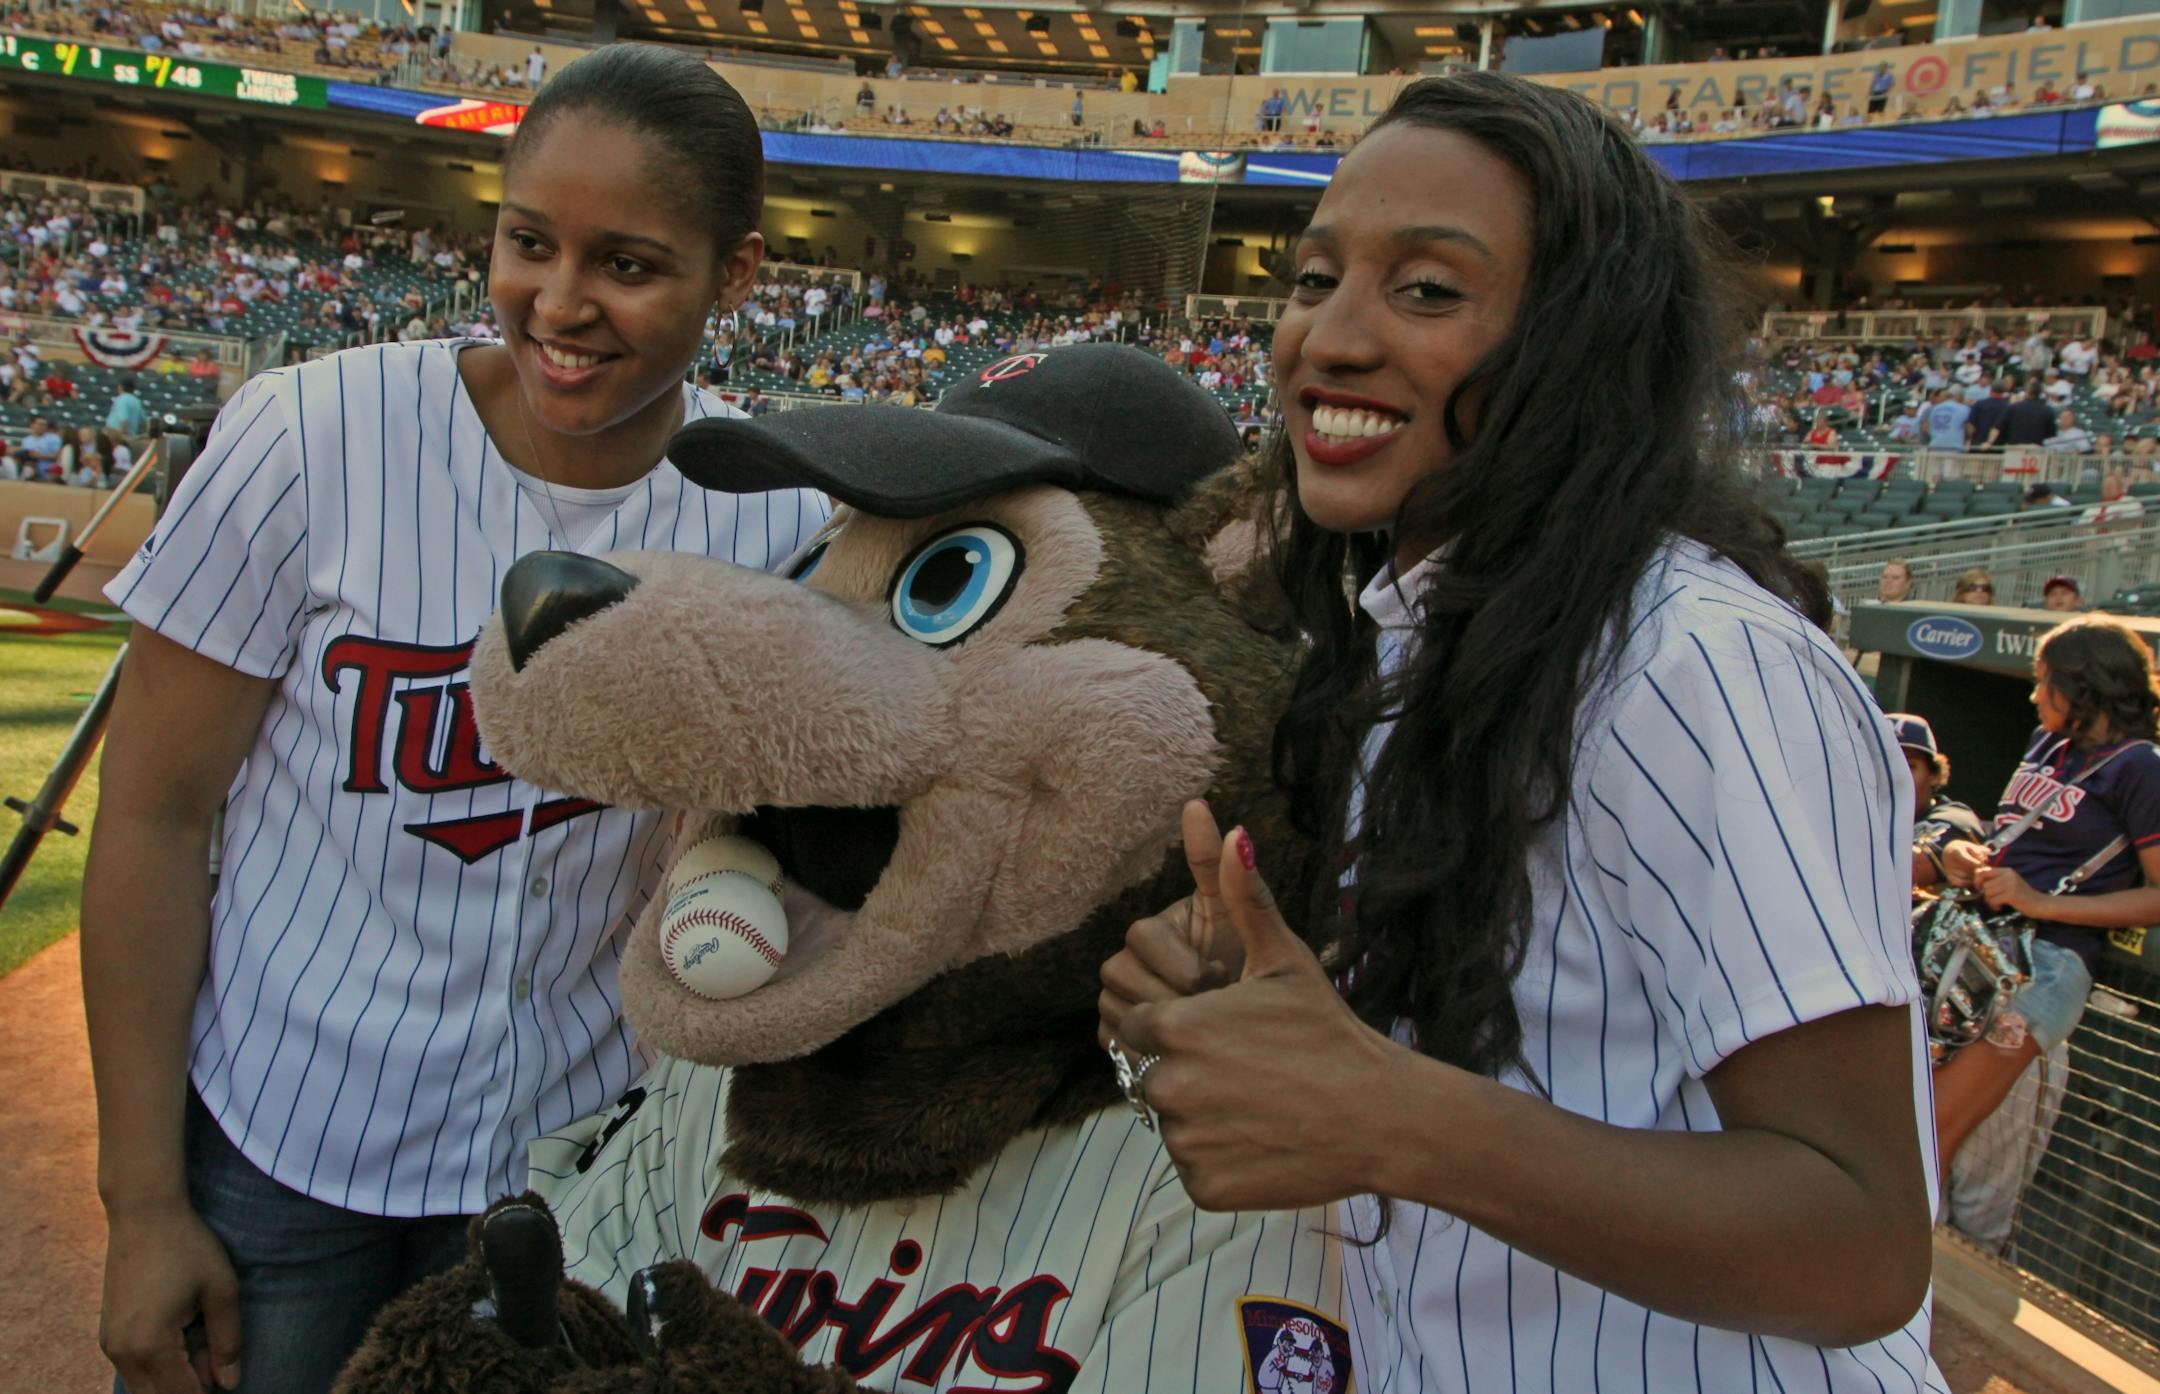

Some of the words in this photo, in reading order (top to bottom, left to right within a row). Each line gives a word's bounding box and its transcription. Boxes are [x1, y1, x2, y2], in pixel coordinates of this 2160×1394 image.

[241, 68, 297, 89] TWINS
[1658, 62, 1895, 109] TARGET
[1963, 34, 2160, 88] FIELD
[237, 81, 299, 105] LINEUP
[1915, 623, 1974, 648] Carrier
[1996, 626, 2039, 656] twi
[701, 1193, 1081, 1394] Twins
